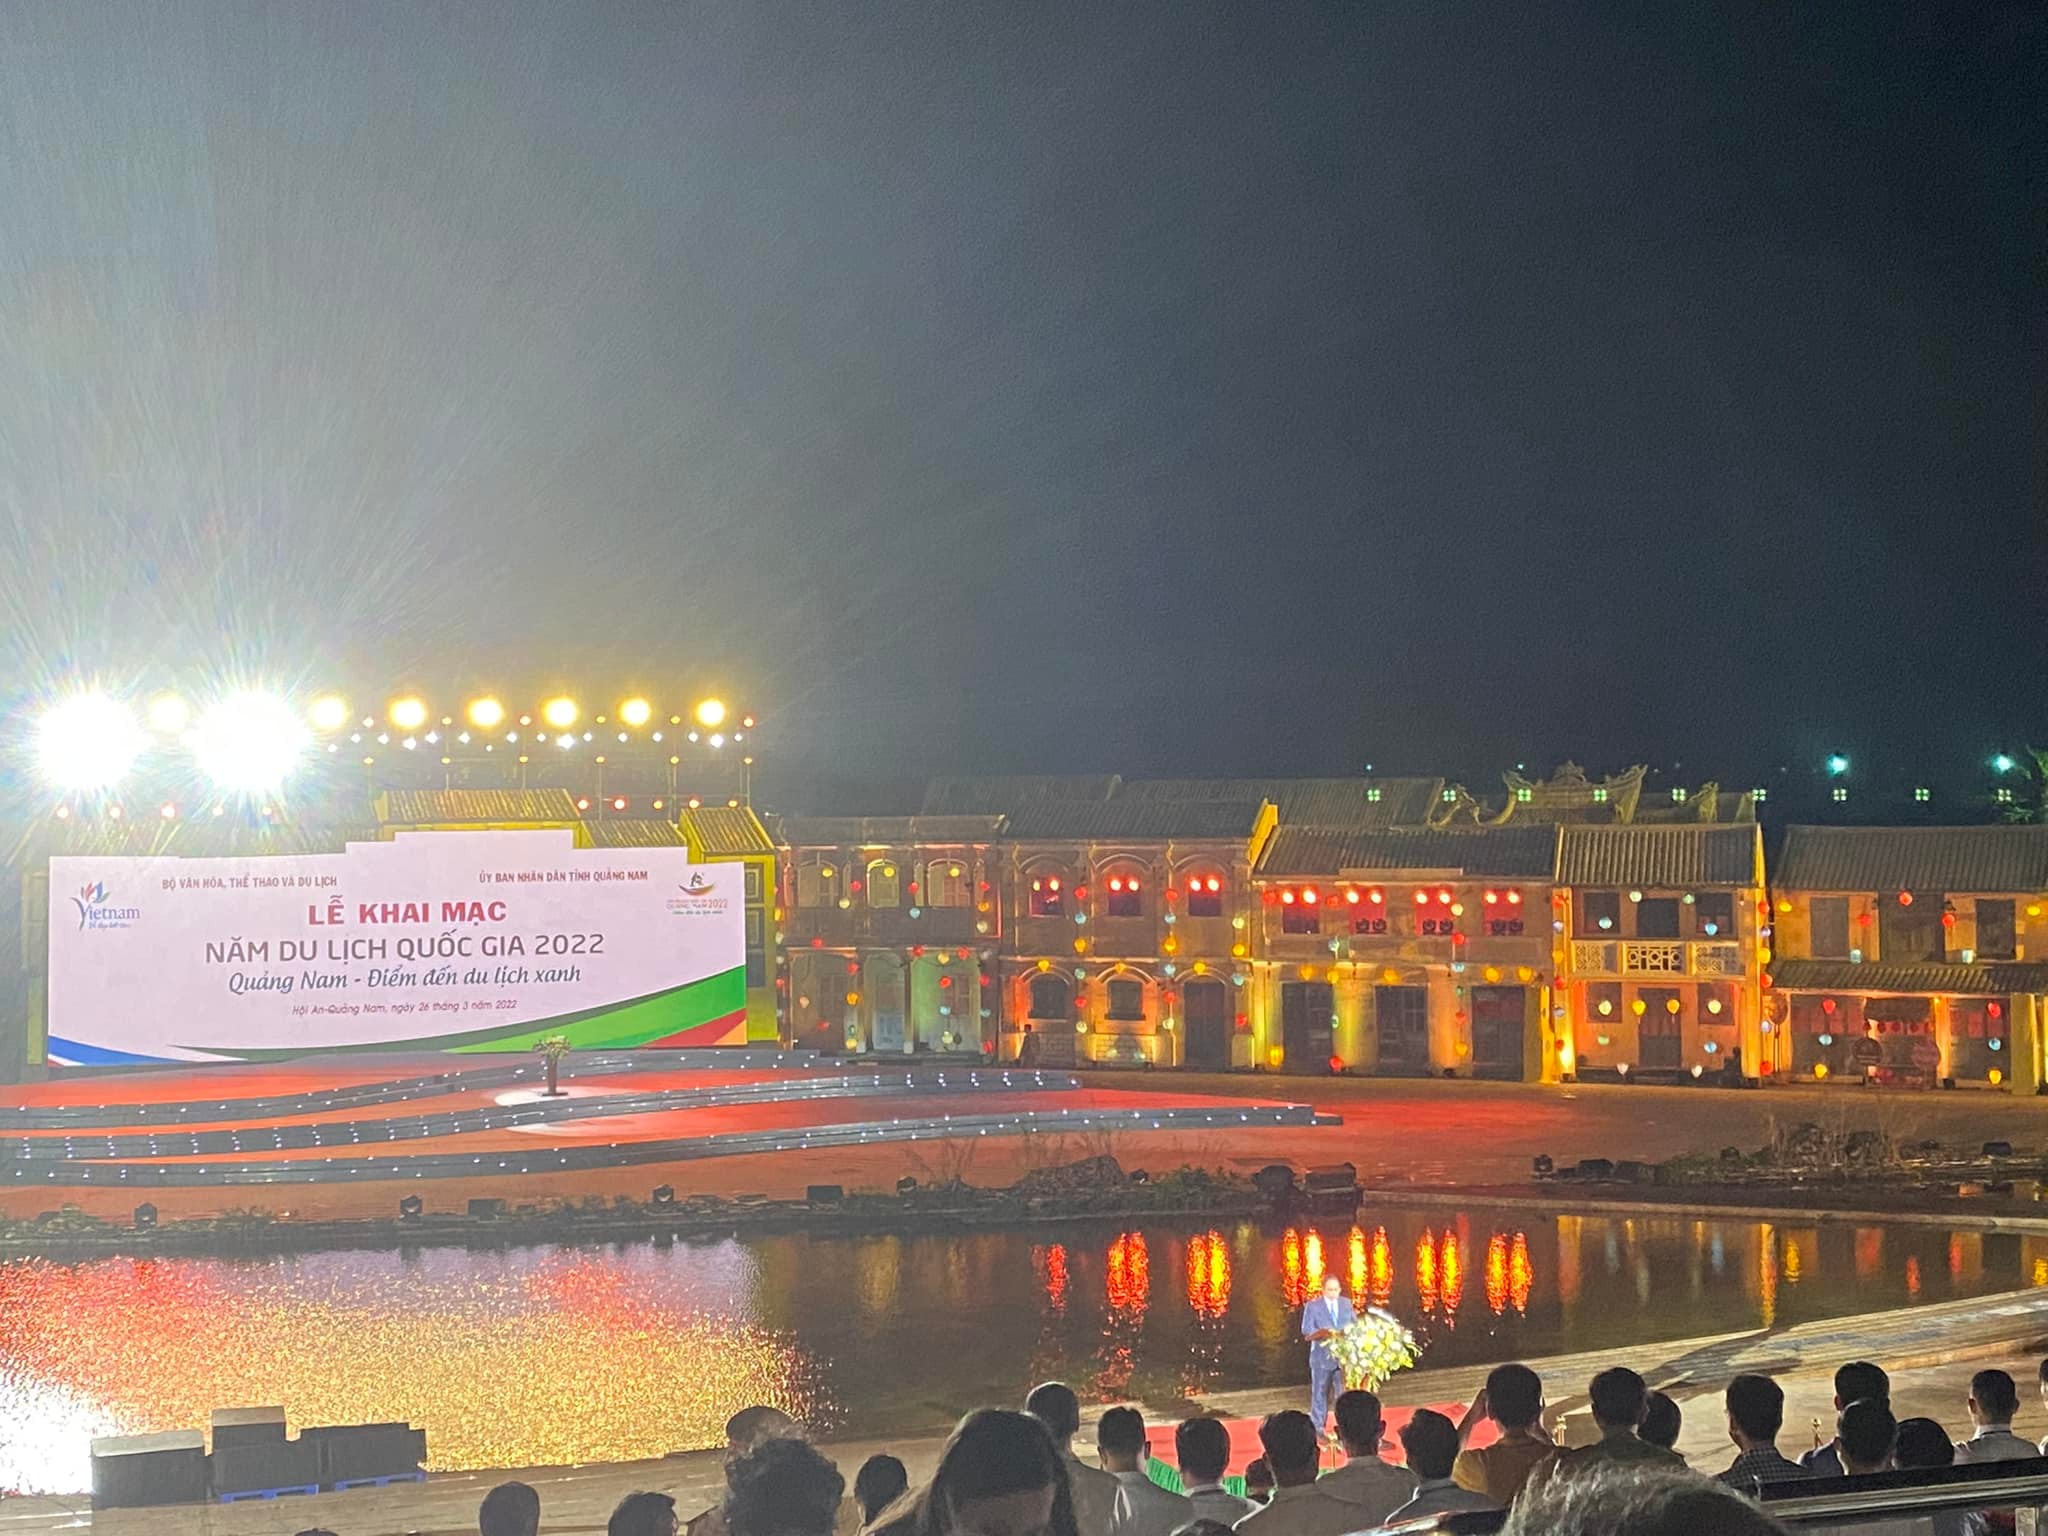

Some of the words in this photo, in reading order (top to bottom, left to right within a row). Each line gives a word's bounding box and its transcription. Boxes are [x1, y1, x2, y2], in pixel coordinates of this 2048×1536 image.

[252, 876, 279, 888] THAO
[283, 874, 295, 887] VÀ
[299, 876, 312, 887] DU
[315, 875, 337, 889] LỊCH
[495, 872, 515, 883] BAN
[517, 870, 544, 883] NHÂN
[546, 869, 566, 882] DÂN
[628, 871, 648, 881] NAM
[69, 896, 141, 931] Vietnam
[309, 895, 344, 925] LỄ
[359, 902, 430, 924] KHAI
[441, 901, 506, 926] MẠC
[206, 936, 269, 963] NĂM
[279, 940, 317, 962] DU
[328, 938, 387, 965] LỊCH
[396, 929, 472, 961] QUỐC
[481, 936, 525, 956] GIA
[535, 934, 604, 955] 2022
[229, 970, 294, 995] Quảng
[300, 970, 348, 990] Nam
[367, 964, 417, 987] Điểm
[423, 964, 457, 986] đến
[463, 967, 488, 984] du
[494, 965, 529, 987] lịch
[534, 965, 581, 983] xanh
[418, 1002, 429, 1011] 26
[462, 1002, 469, 1010] 3
[495, 1000, 517, 1009] 2022
